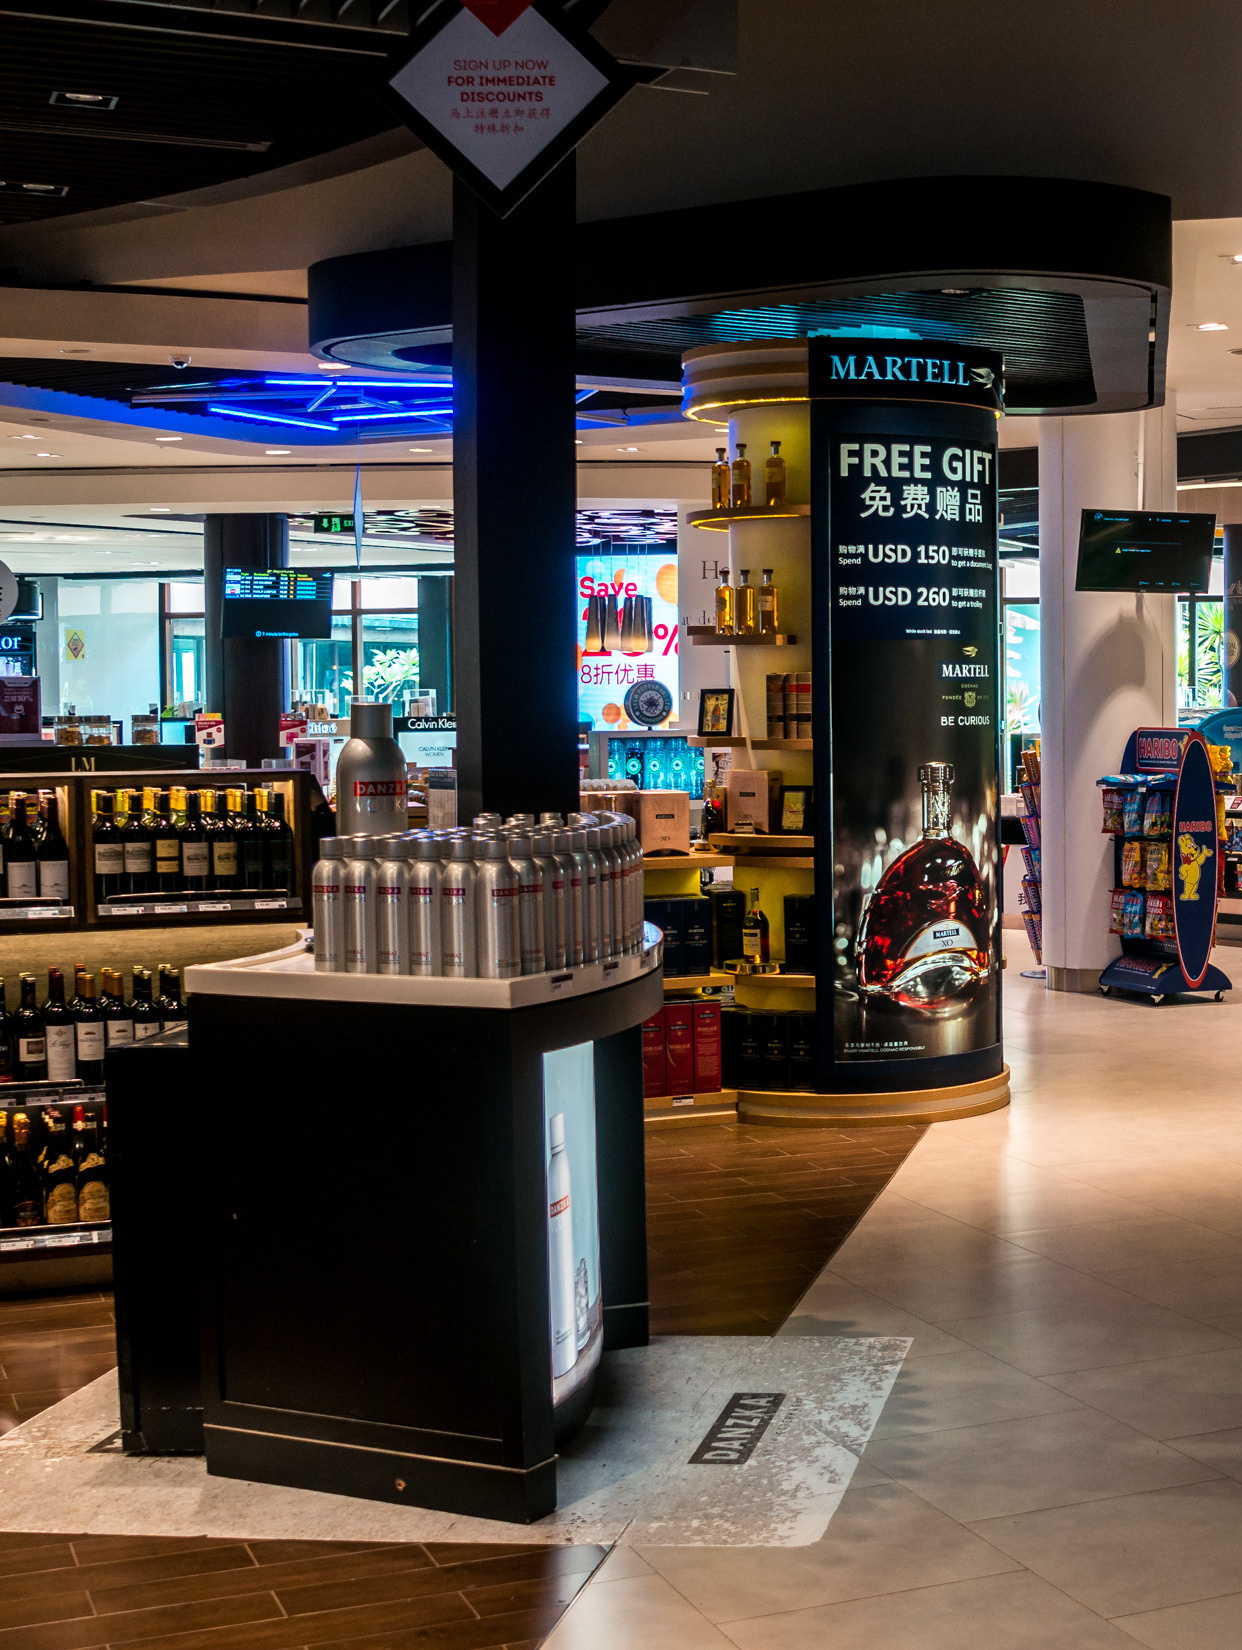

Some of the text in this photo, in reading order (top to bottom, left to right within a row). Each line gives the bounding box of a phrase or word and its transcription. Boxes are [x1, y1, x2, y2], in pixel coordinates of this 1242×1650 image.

[453, 60, 549, 71] SIGN UP NOW
[447, 76, 556, 86] FOR IMMEDIATE
[460, 91, 543, 102] DISCOUNTS
[830, 355, 970, 386] MARTELL
[840, 443, 992, 485] FREE GIFT
[860, 482, 983, 523] 免费赠品
[343, 519, 354, 527] EXI
[868, 544, 949, 564] USD 150
[838, 557, 861, 565] Spend
[579, 576, 638, 599] Save
[838, 598, 862, 607] Spend
[868, 587, 949, 606] USD 260
[580, 663, 656, 685] 8折优惠
[942, 664, 989, 677] MARTELL
[407, 718, 457, 729] Calvin Klei
[940, 715, 990, 726] BE CURIOUS
[1139, 738, 1179, 759] HARIBO
[71, 757, 96, 772] LM
[1178, 820, 1212, 832] HARIBO
[934, 929, 959, 938] MARTELL
[940, 938, 953, 947] XO
[701, 1396, 776, 1460] DANZKA
